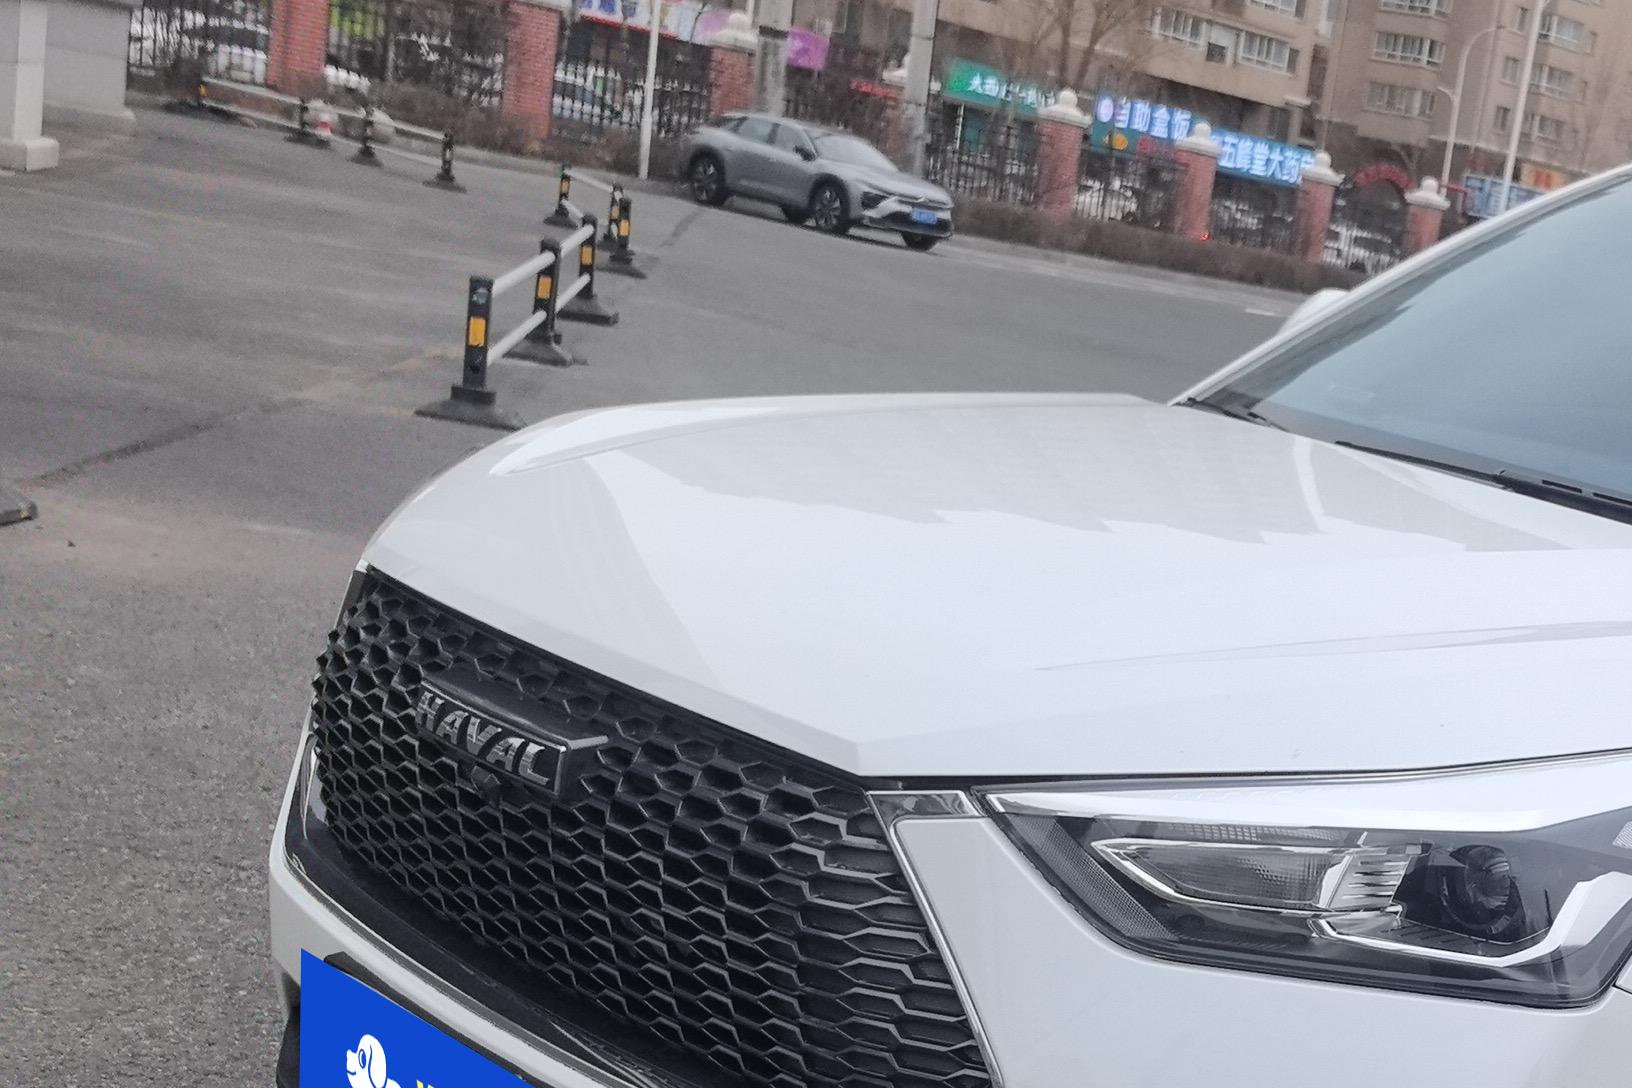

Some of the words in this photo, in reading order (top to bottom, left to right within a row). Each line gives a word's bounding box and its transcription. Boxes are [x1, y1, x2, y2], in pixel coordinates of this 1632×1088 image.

[1211, 133, 1316, 183] 五峰堂大药
[415, 690, 549, 785] HAVAL
